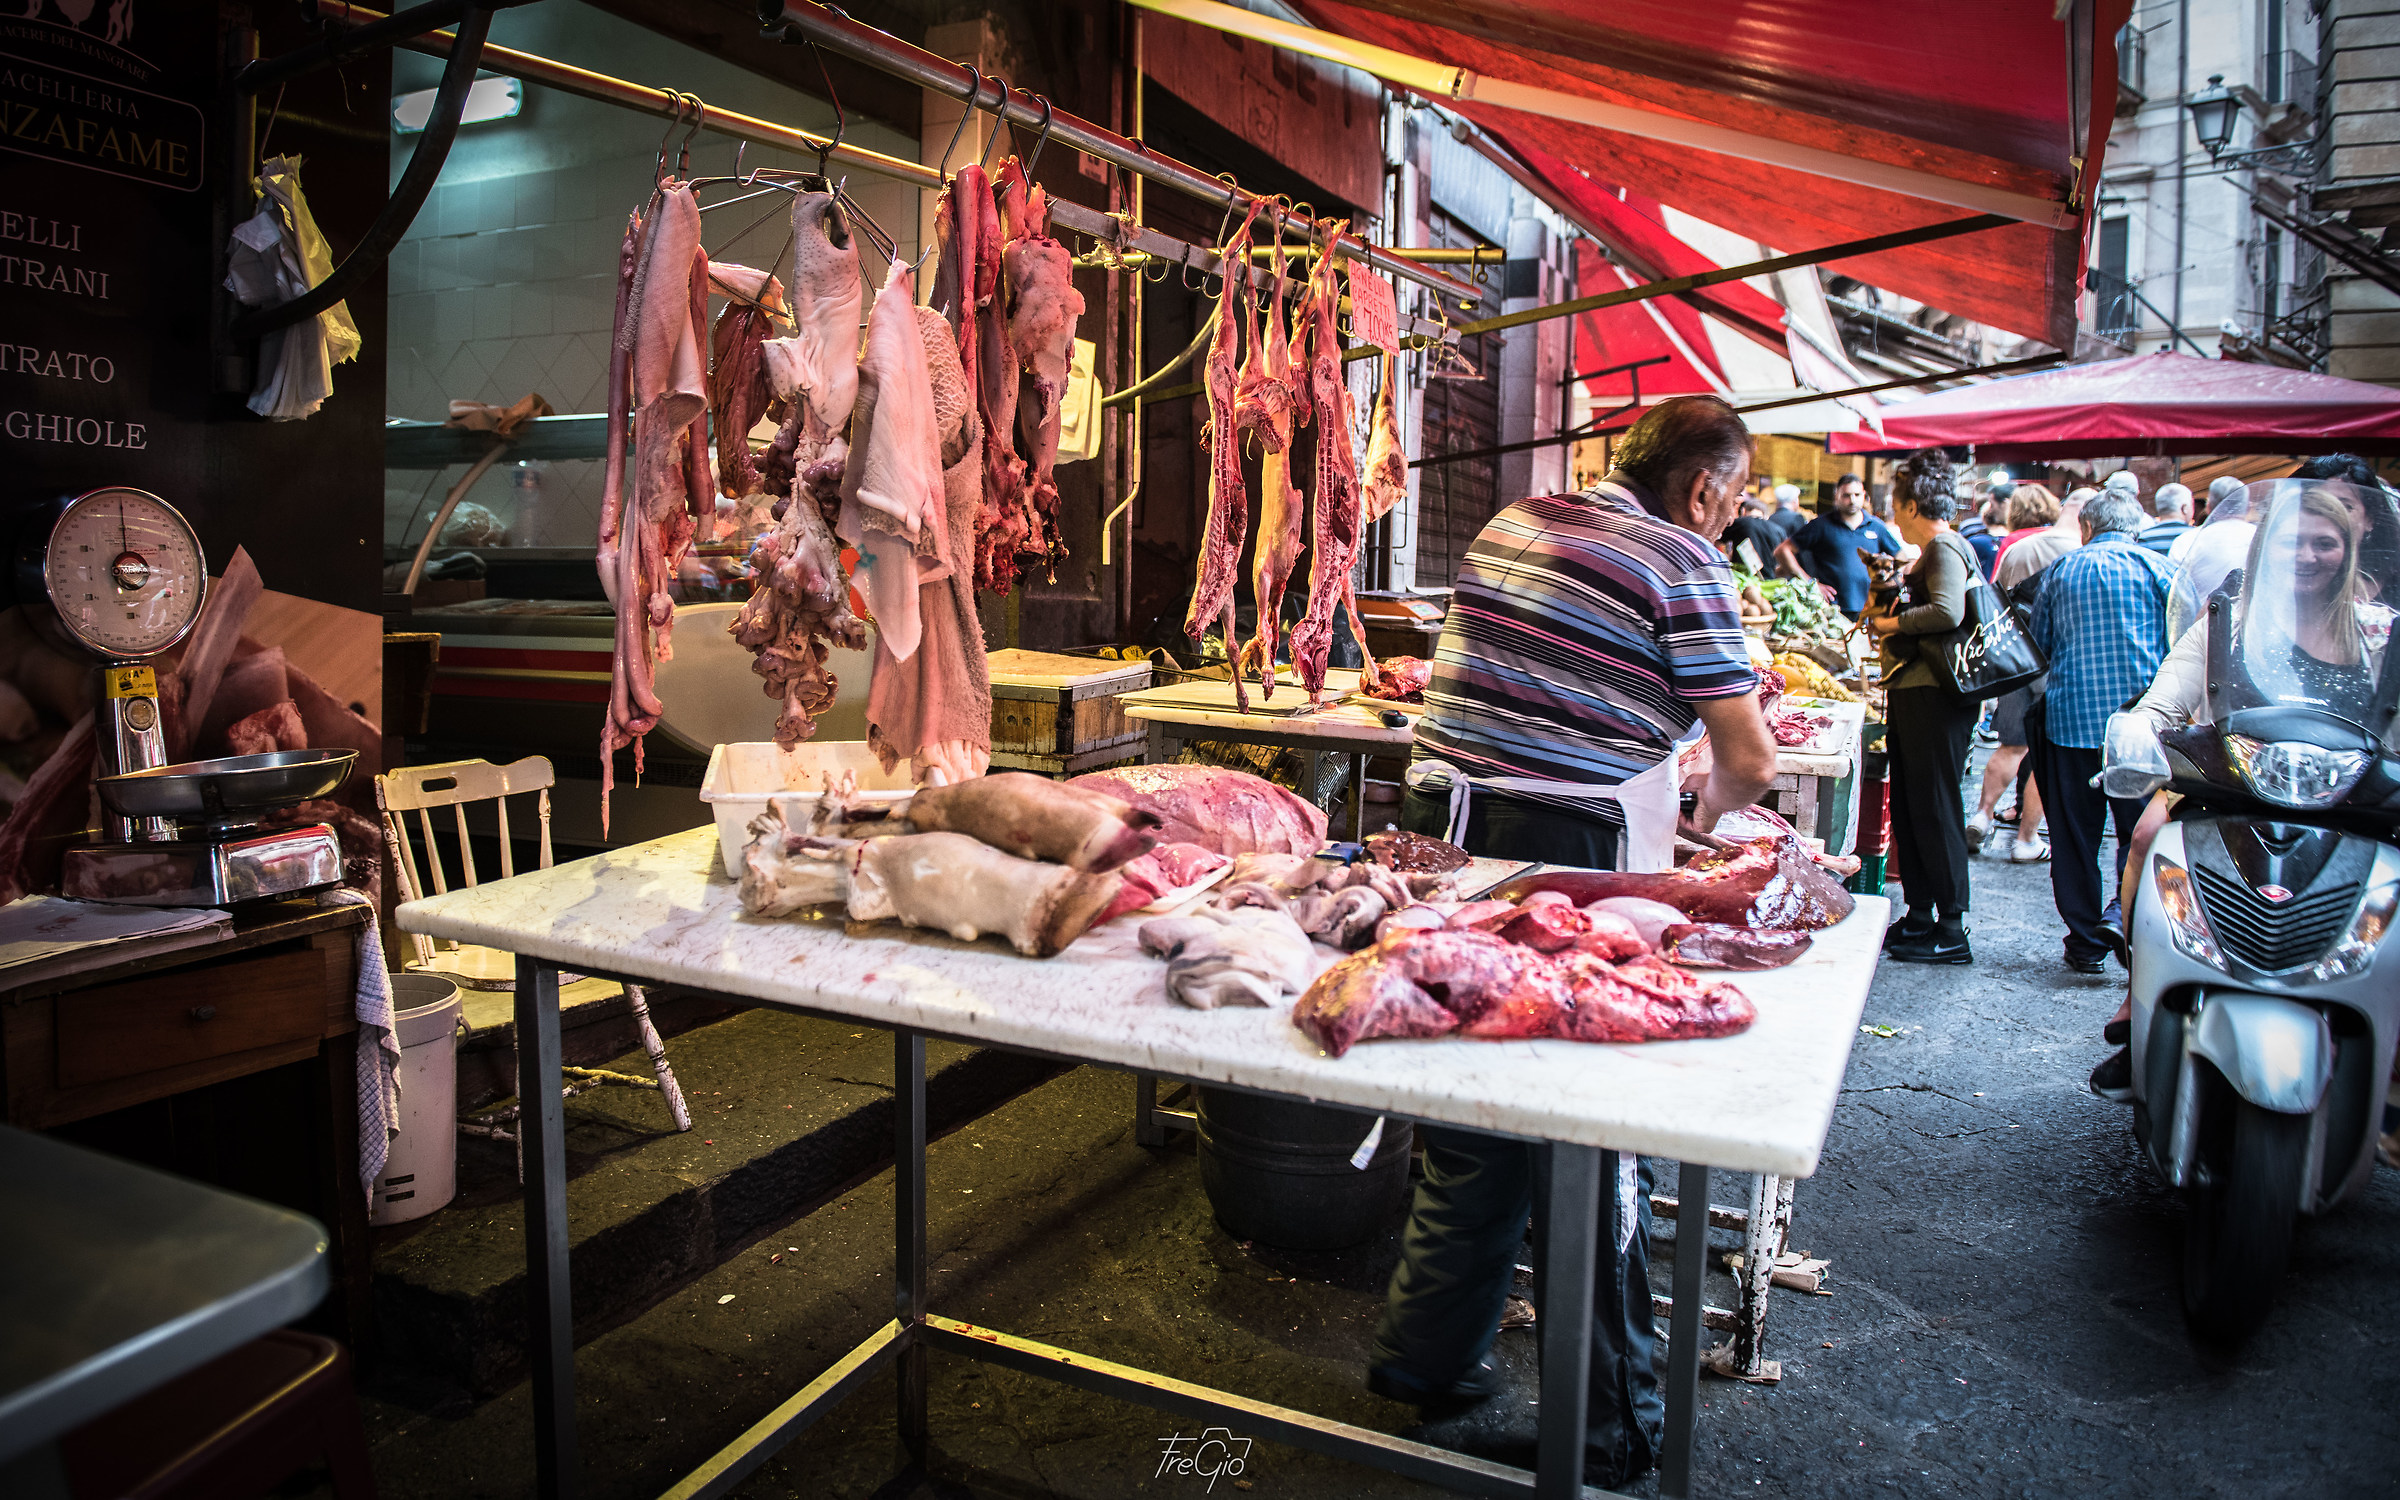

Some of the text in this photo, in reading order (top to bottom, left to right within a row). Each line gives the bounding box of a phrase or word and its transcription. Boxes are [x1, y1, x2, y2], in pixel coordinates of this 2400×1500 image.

[1, 69, 140, 120] ACELLERIA
[0, 210, 82, 253] ELLI
[0, 254, 111, 300] TRANI
[1351, 262, 1386, 298] AGNELLI
[1352, 284, 1391, 320] CAPRETTI
[0, 343, 116, 384] TRATO
[0, 410, 148, 451] GHIOLE
